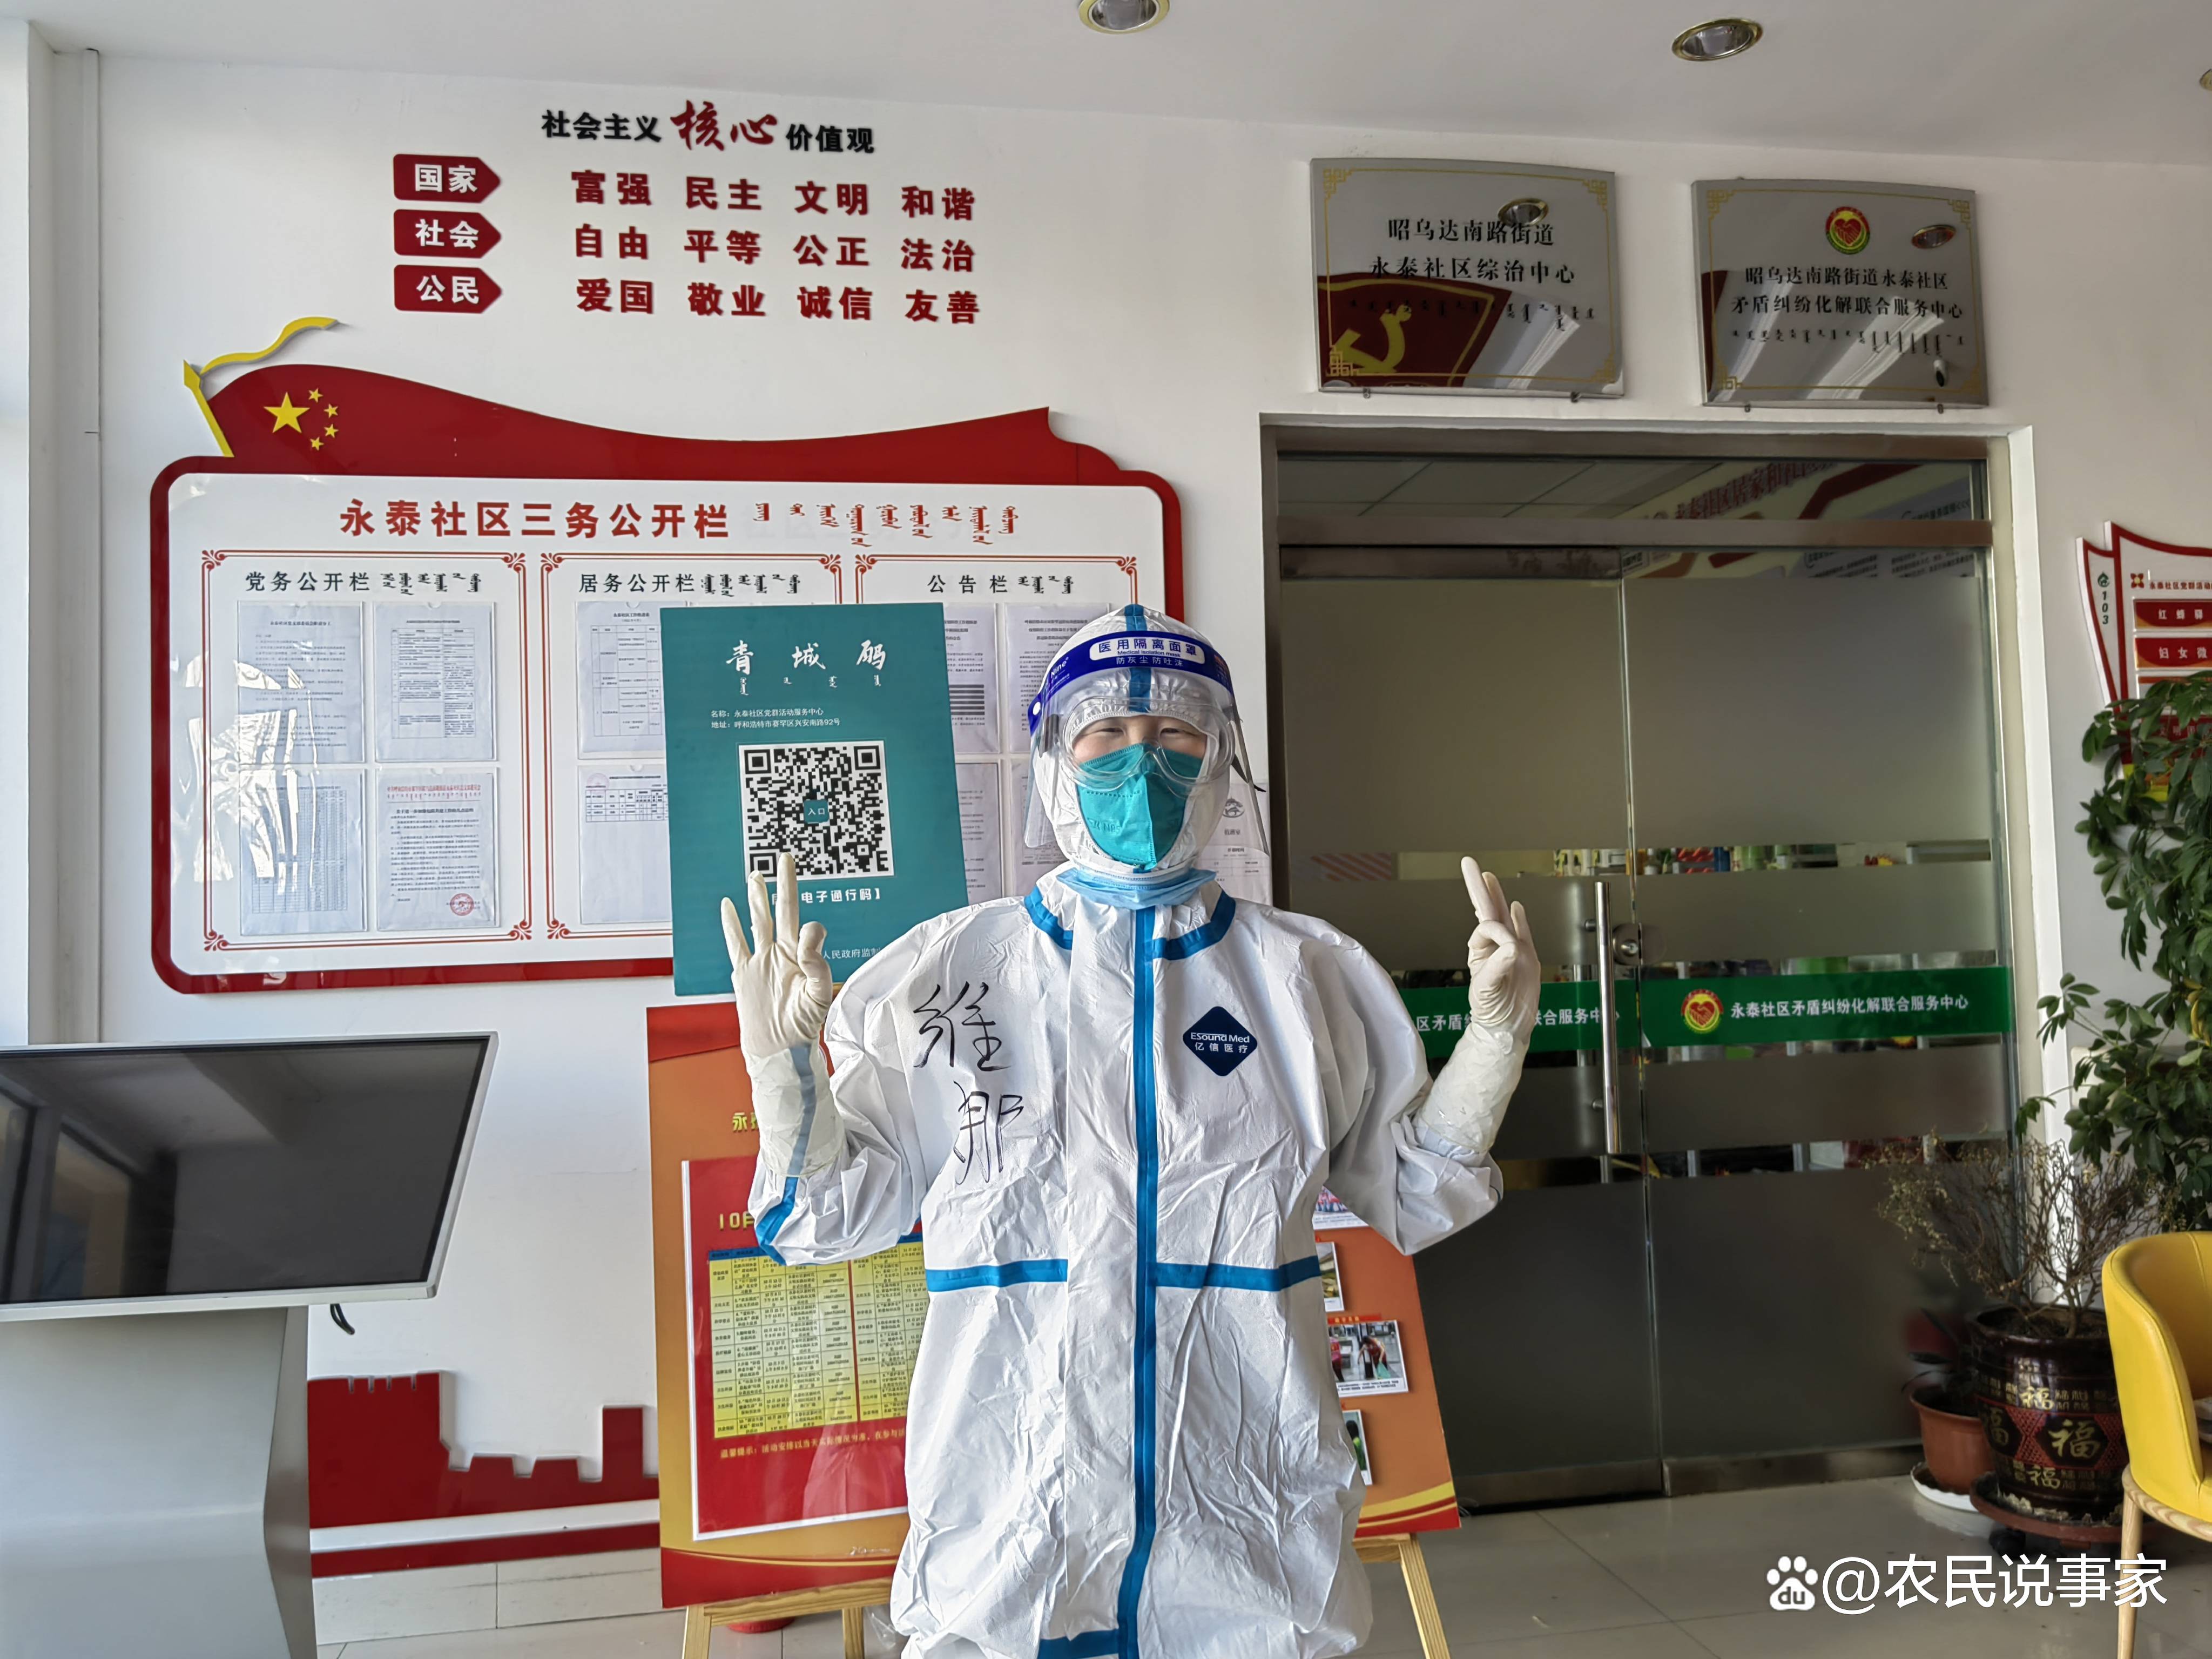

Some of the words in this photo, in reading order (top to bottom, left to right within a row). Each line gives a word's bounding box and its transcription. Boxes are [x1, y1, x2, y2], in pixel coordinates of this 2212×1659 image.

[414, 164, 477, 194] 国家
[571, 170, 652, 207] 富强
[685, 177, 761, 211] 民主
[794, 181, 868, 215] 文明
[901, 186, 975, 222] 和谐
[415, 219, 480, 248] 社会
[1388, 218, 1554, 246] 昭乌达南路街道
[575, 224, 648, 260] 自由
[684, 230, 761, 265] 平等
[793, 235, 869, 267] 公正
[900, 239, 974, 273] 法治
[1370, 257, 1575, 284] 永泰社区综治中心
[1745, 267, 1948, 291] 昭乌达南路街道永泰社区
[416, 276, 480, 305] 公民
[576, 279, 654, 314] 爱国
[687, 282, 766, 318] 敬业
[797, 286, 872, 320] 诚信
[904, 290, 980, 323] 友善
[1731, 296, 1963, 319] 矛盾纠纷化解联合服务中心
[340, 498, 729, 538] 永泰社区三务公开栏
[245, 571, 370, 592] 党务公开栏
[579, 573, 694, 594] 居务公开栏
[927, 574, 1008, 594] 公告栏
[726, 639, 886, 675] 青城码
[1099, 638, 1197, 656] 医用隔离面罩
[1731, 994, 1968, 1018] 永泰社区矛盾纠纷化解联合服务中心
[1195, 1042, 1248, 1054] 亿信医疗
[1229, 1034, 1250, 1043] Med
[2020, 1386, 2054, 1410] 福
[2048, 1419, 2101, 1459] 福
[2026, 1465, 2061, 1489] 福
